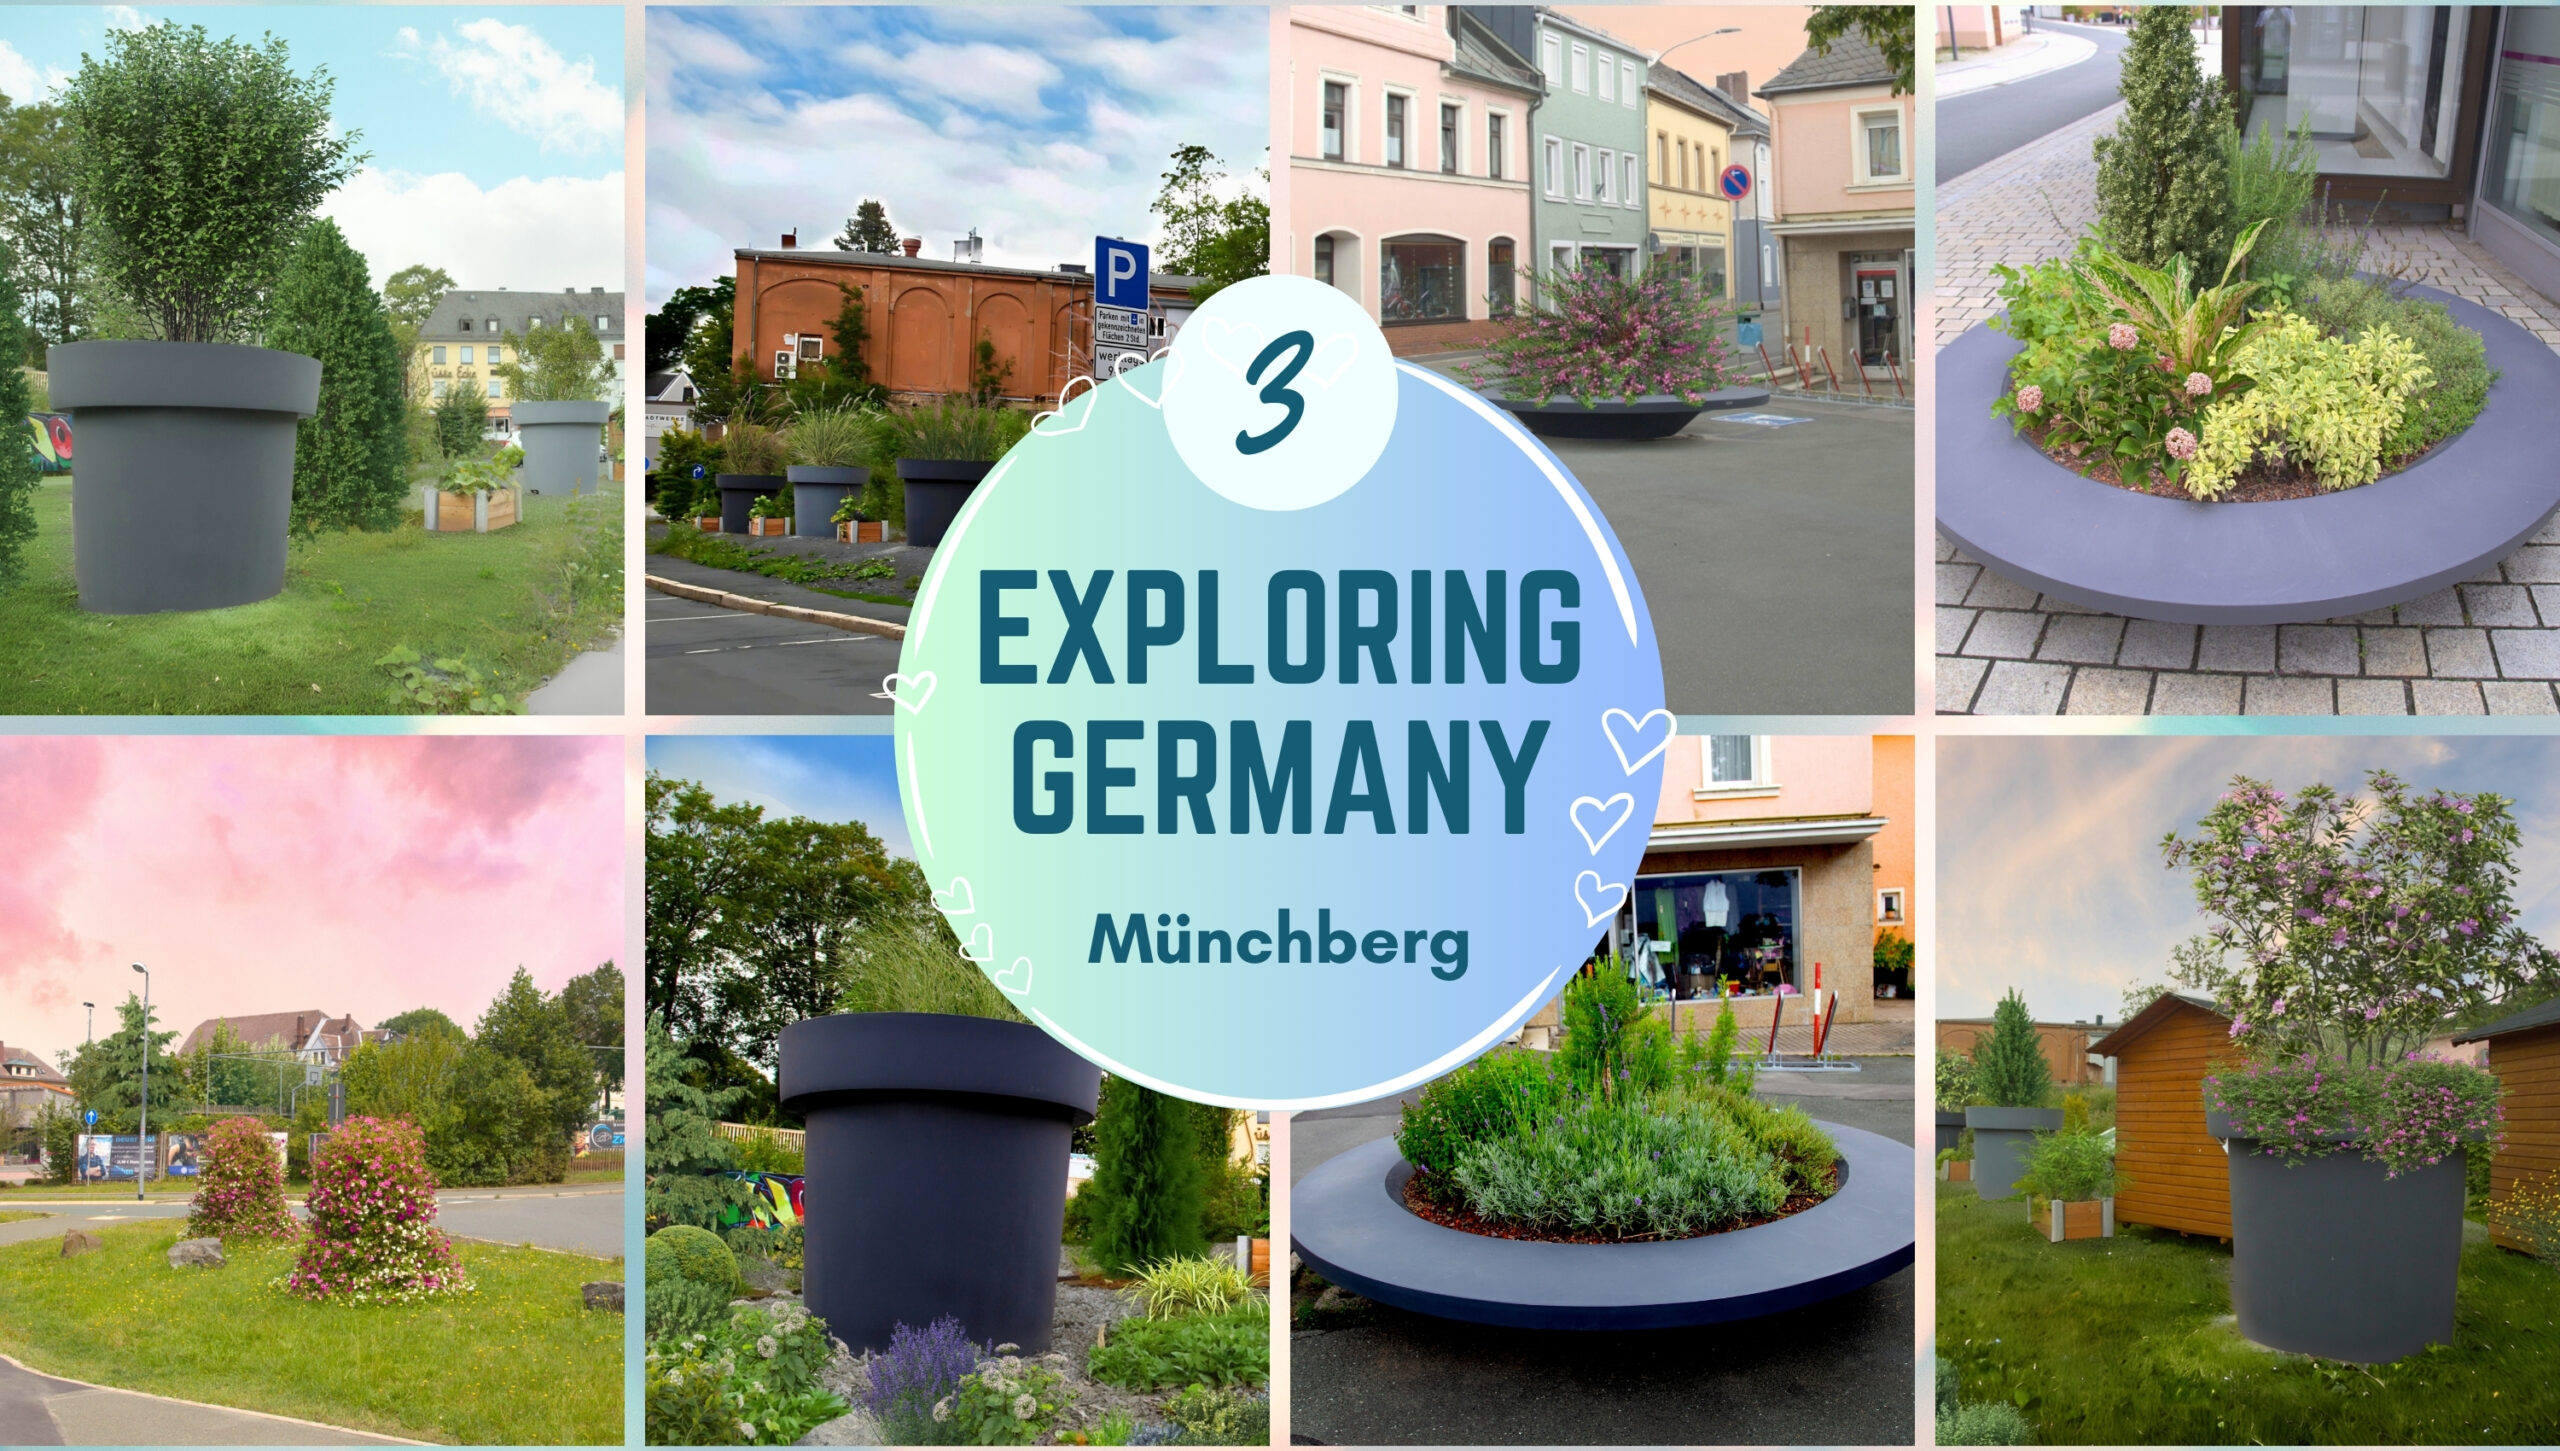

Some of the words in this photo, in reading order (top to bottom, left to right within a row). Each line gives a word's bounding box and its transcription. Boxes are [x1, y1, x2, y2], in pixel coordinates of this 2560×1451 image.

[1108, 247, 1136, 297] P
[1099, 310, 1118, 321] Parken
[1120, 314, 1130, 322] mit
[1138, 316, 1145, 324] in
[1097, 321, 1146, 335] gekennzeichneten
[1102, 330, 1124, 341] Flächen
